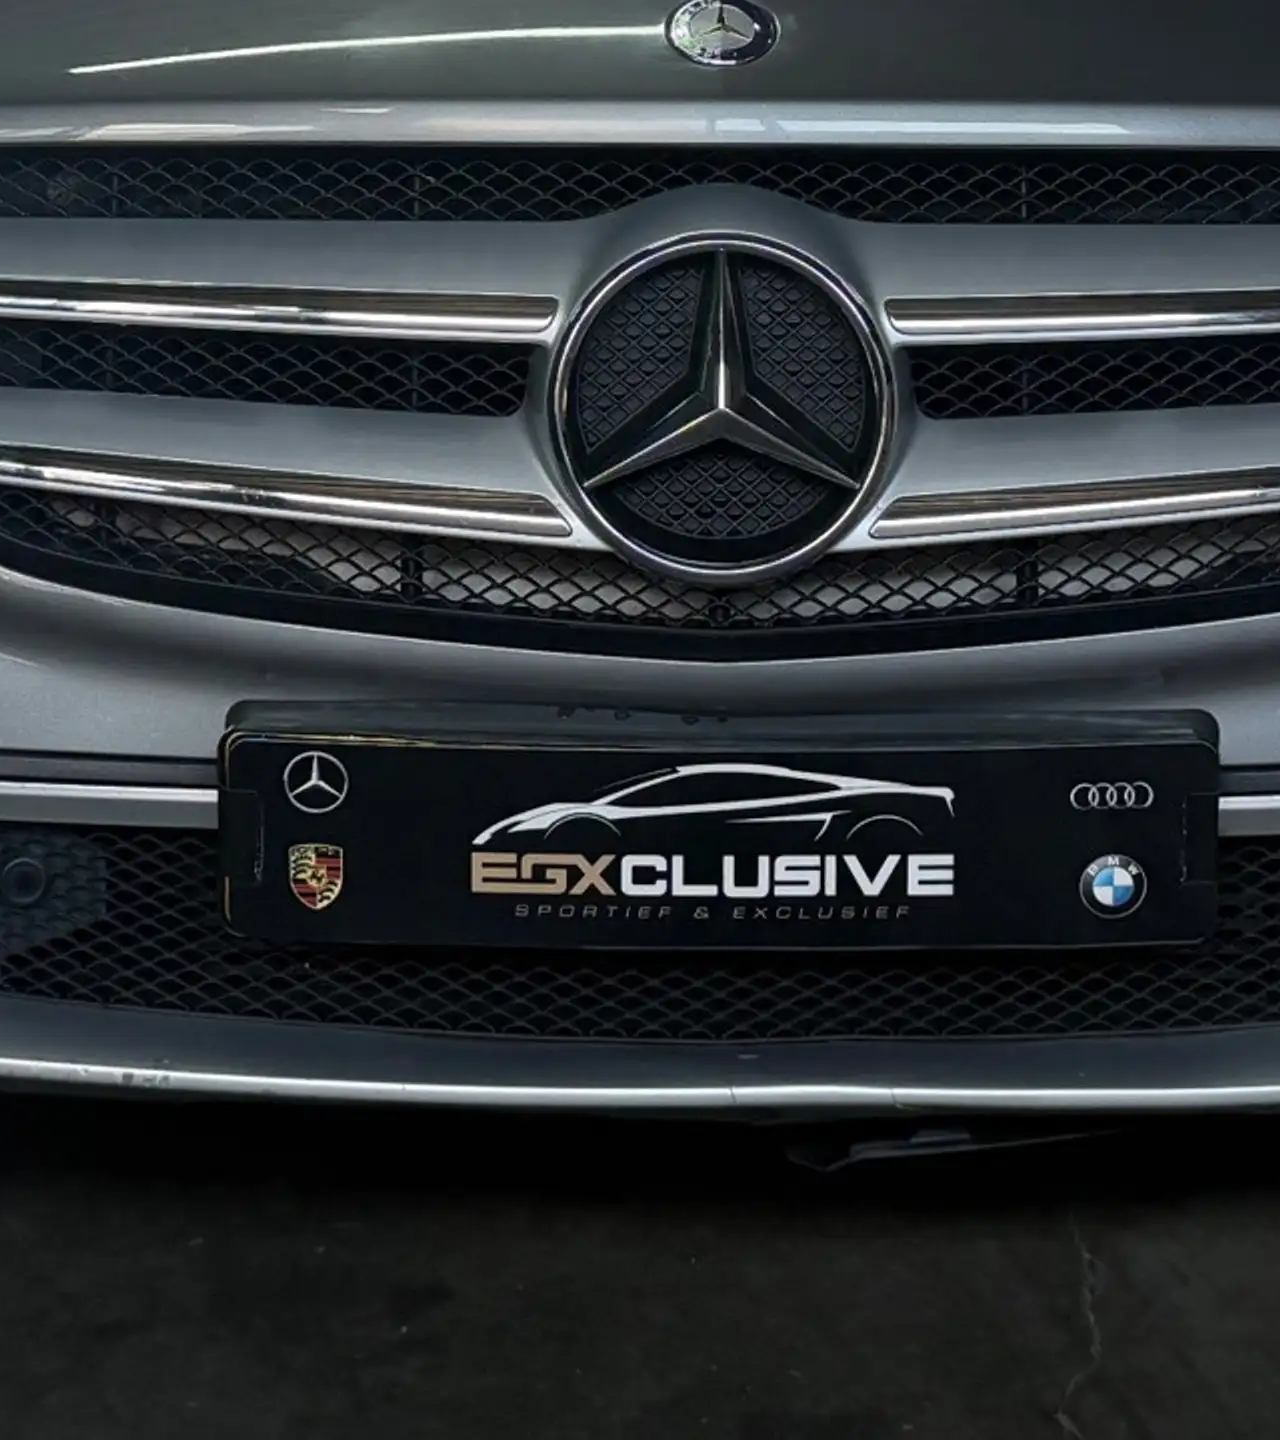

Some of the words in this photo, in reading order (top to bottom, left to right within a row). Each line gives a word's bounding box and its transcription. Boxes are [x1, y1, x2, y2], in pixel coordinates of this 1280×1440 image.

[471, 851, 956, 898] EGXCLUSIVE
[514, 903, 673, 918] SPORTIEF
[692, 905, 711, 920] &
[732, 905, 911, 920] EXCLUSIEF
